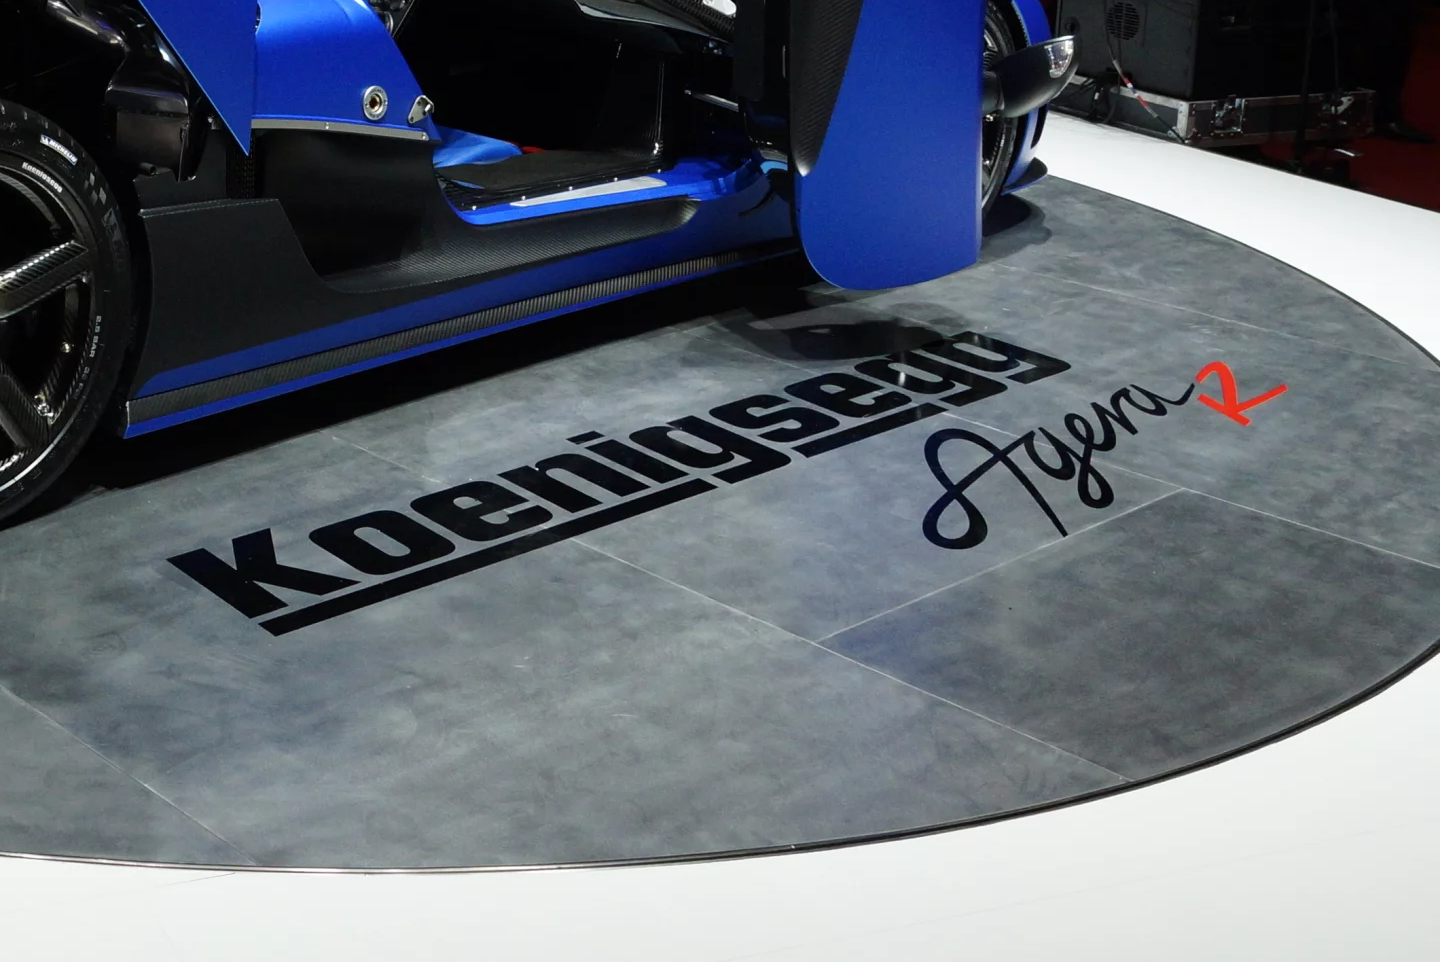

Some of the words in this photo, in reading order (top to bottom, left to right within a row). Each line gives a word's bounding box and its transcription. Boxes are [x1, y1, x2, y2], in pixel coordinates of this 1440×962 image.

[166, 330, 1073, 636] Koenigsegg
[921, 382, 1197, 551] Agera
[1195, 360, 1289, 427] R
